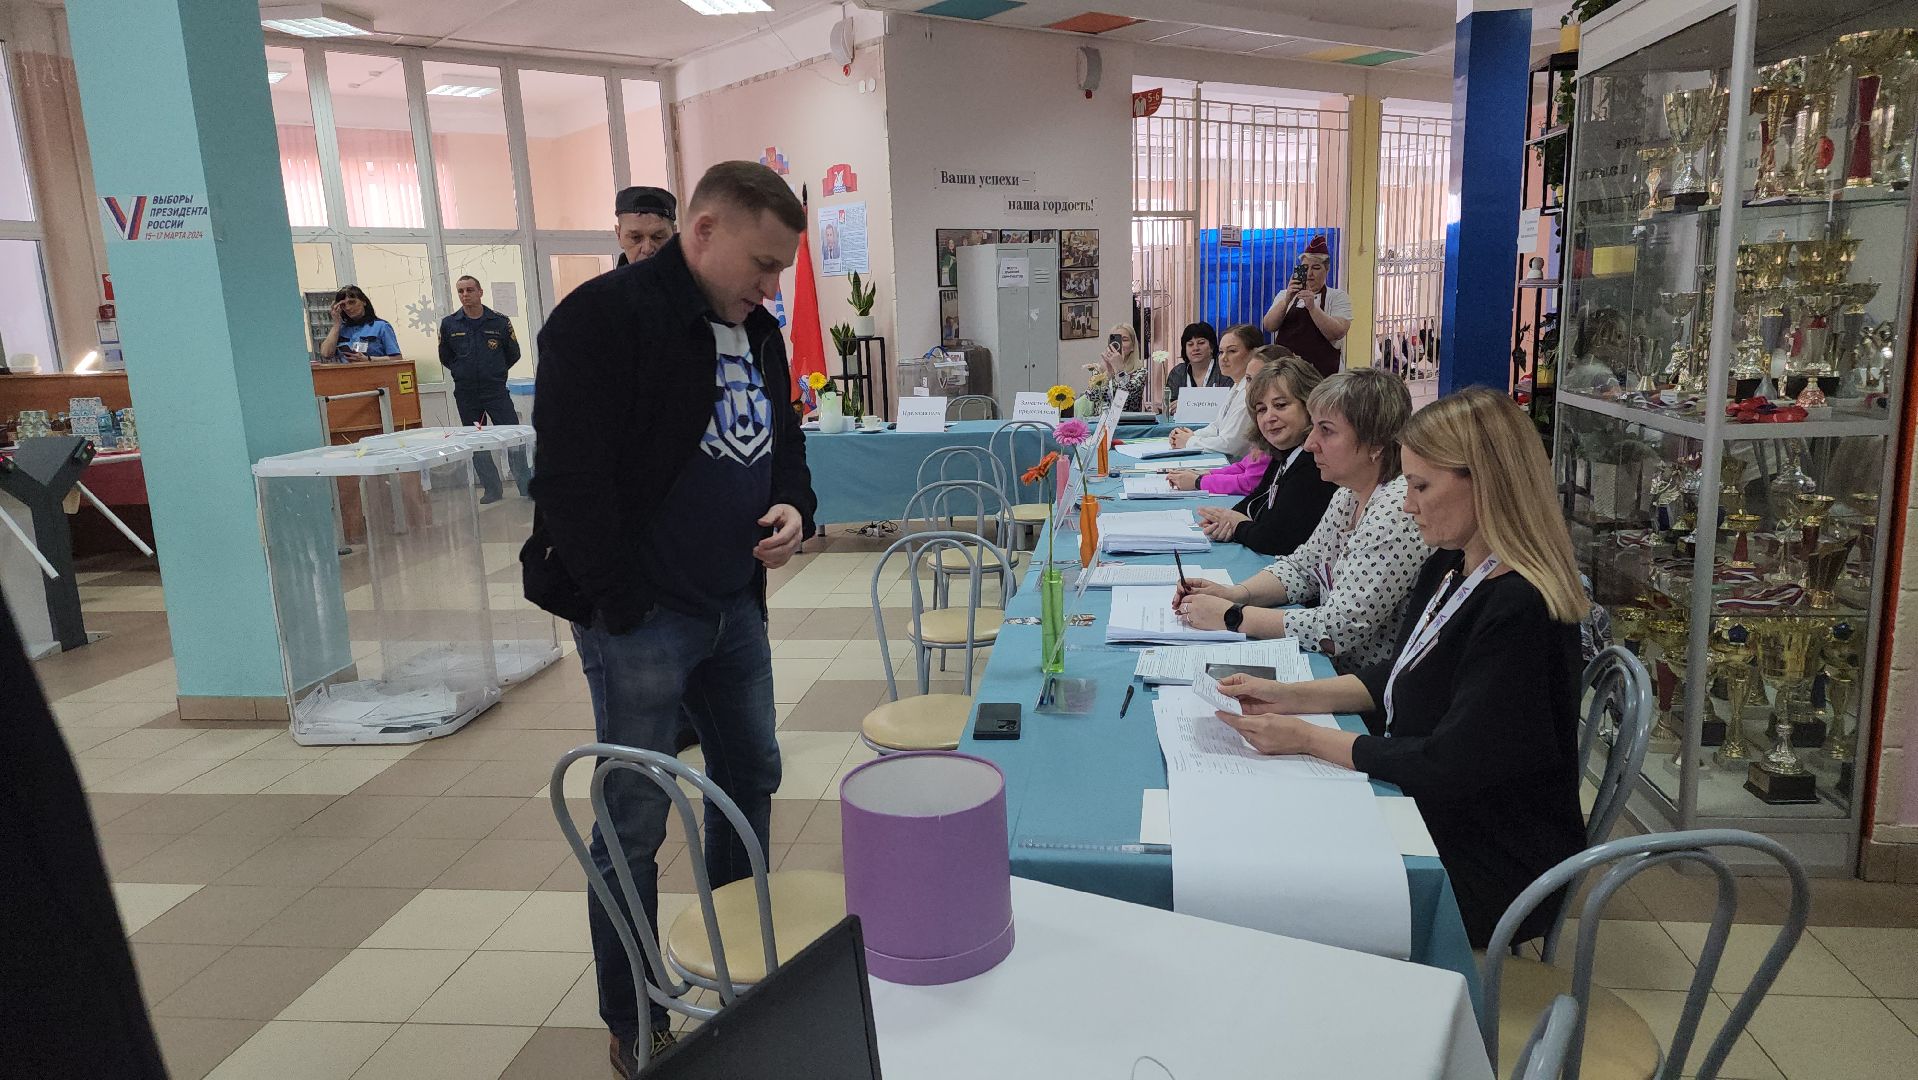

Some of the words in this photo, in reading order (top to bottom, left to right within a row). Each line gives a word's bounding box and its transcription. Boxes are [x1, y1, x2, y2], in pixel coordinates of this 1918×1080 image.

[941, 171, 976, 185] Ваши
[979, 174, 1019, 188] успехи
[152, 195, 193, 204] ВЫБОРЫ
[150, 206, 208, 217] ПРЕЗИДЕНТА
[1008, 200, 1040, 211] наша
[1042, 199, 1095, 215] гордость!
[147, 220, 184, 229] РОССИИ
[163, 231, 187, 240] МАРТА
[187, 231, 204, 240] 2024
